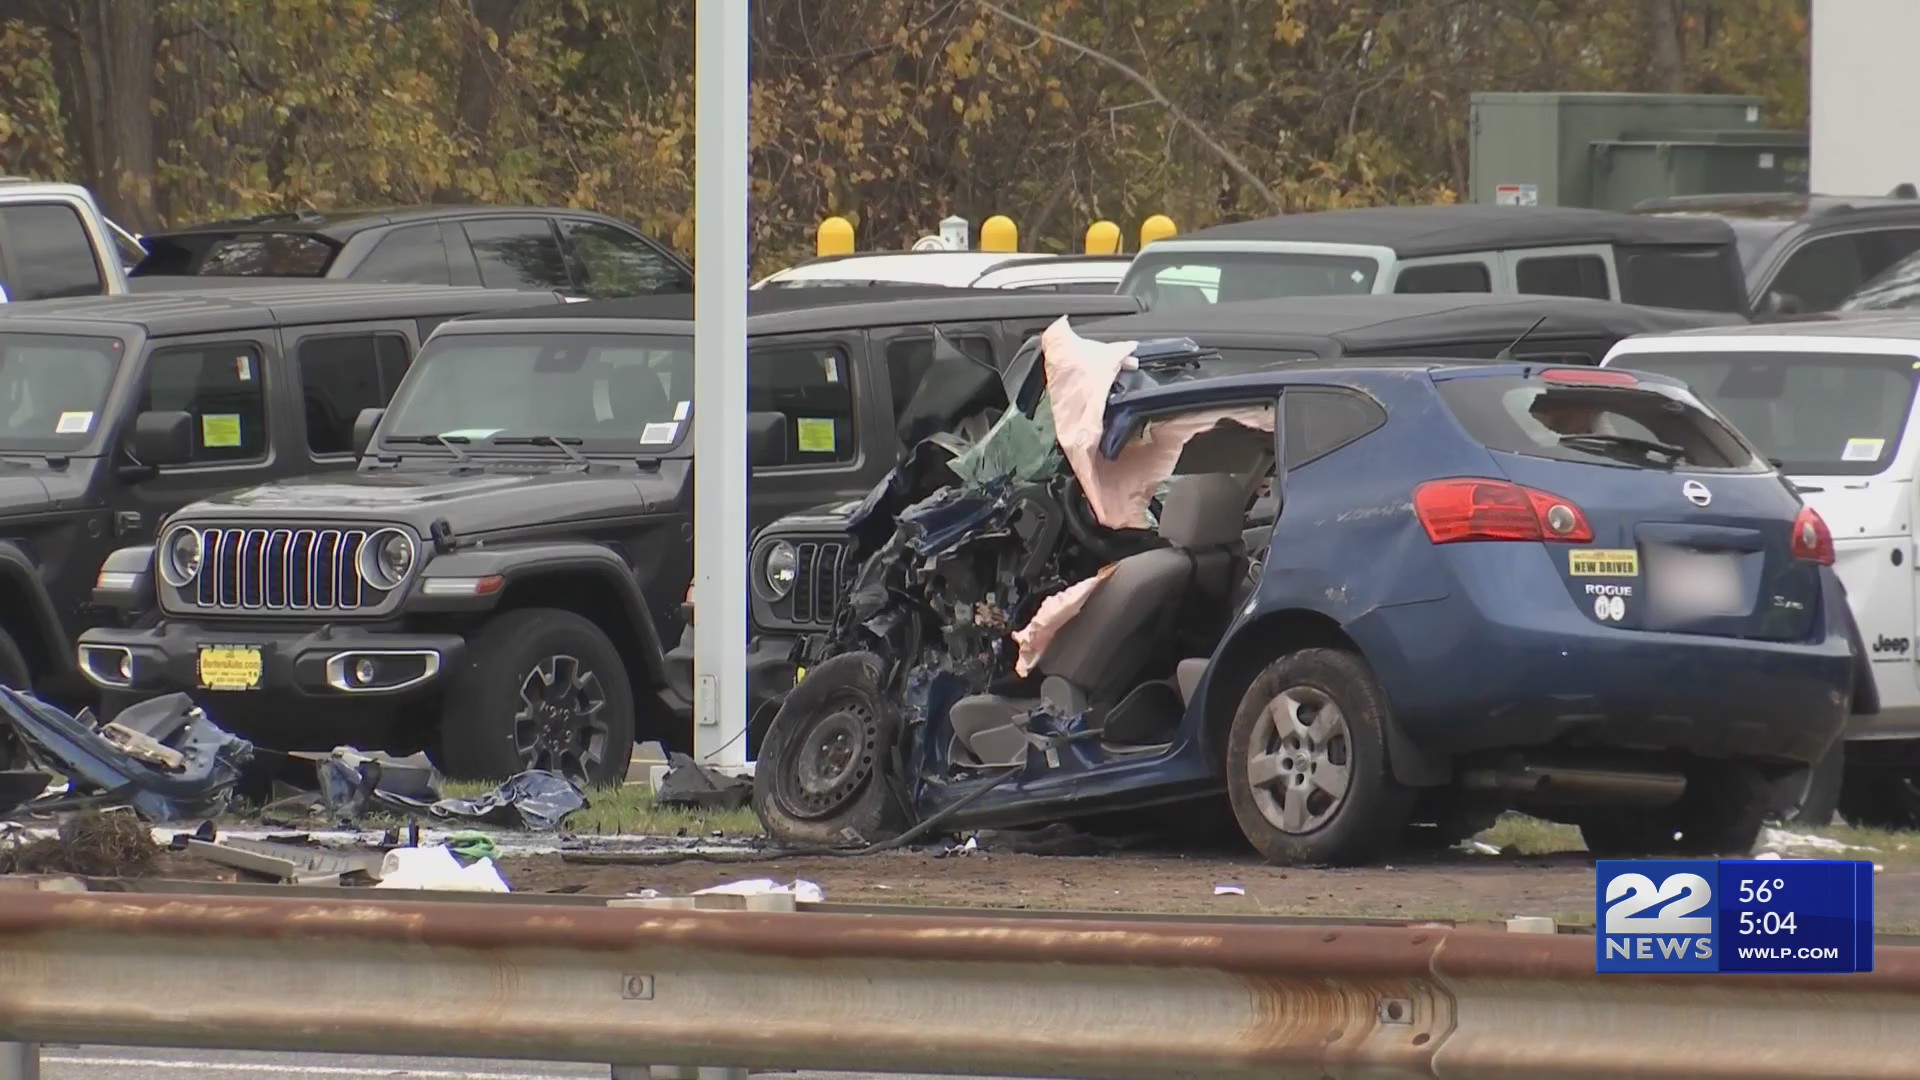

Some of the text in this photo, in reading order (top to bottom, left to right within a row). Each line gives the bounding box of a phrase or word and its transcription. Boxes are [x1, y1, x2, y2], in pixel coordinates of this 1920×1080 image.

[1574, 561, 1634, 573] NEW DRIVER
[1585, 584, 1632, 596] ROGUE
[1872, 633, 1910, 655] Jeep
